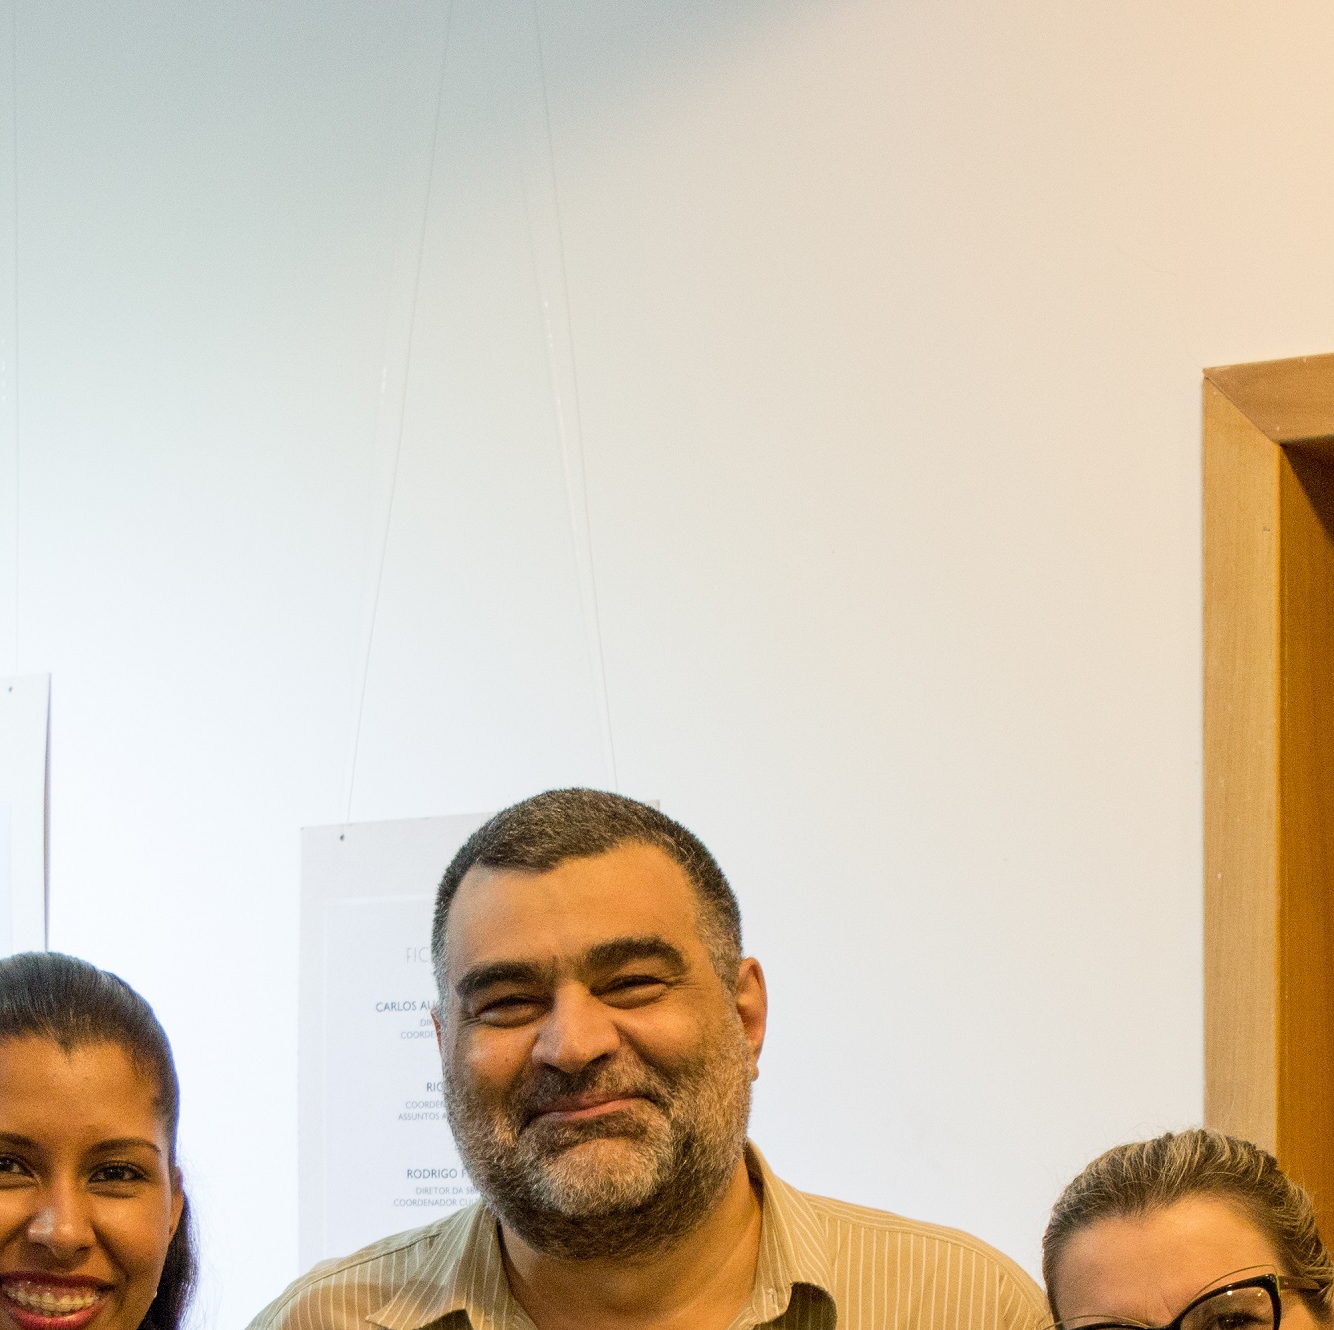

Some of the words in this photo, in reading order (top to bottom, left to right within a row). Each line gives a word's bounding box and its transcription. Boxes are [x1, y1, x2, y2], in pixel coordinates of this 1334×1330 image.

[375, 1000, 417, 1013] CARLOS
[398, 1112, 439, 1121] ASSUNTOS
[406, 1168, 458, 1179] RODRIGO
[416, 1186, 449, 1195] DIRETOR
[452, 1186, 464, 1195] DA
[393, 1198, 457, 1207] COORDENADOR
